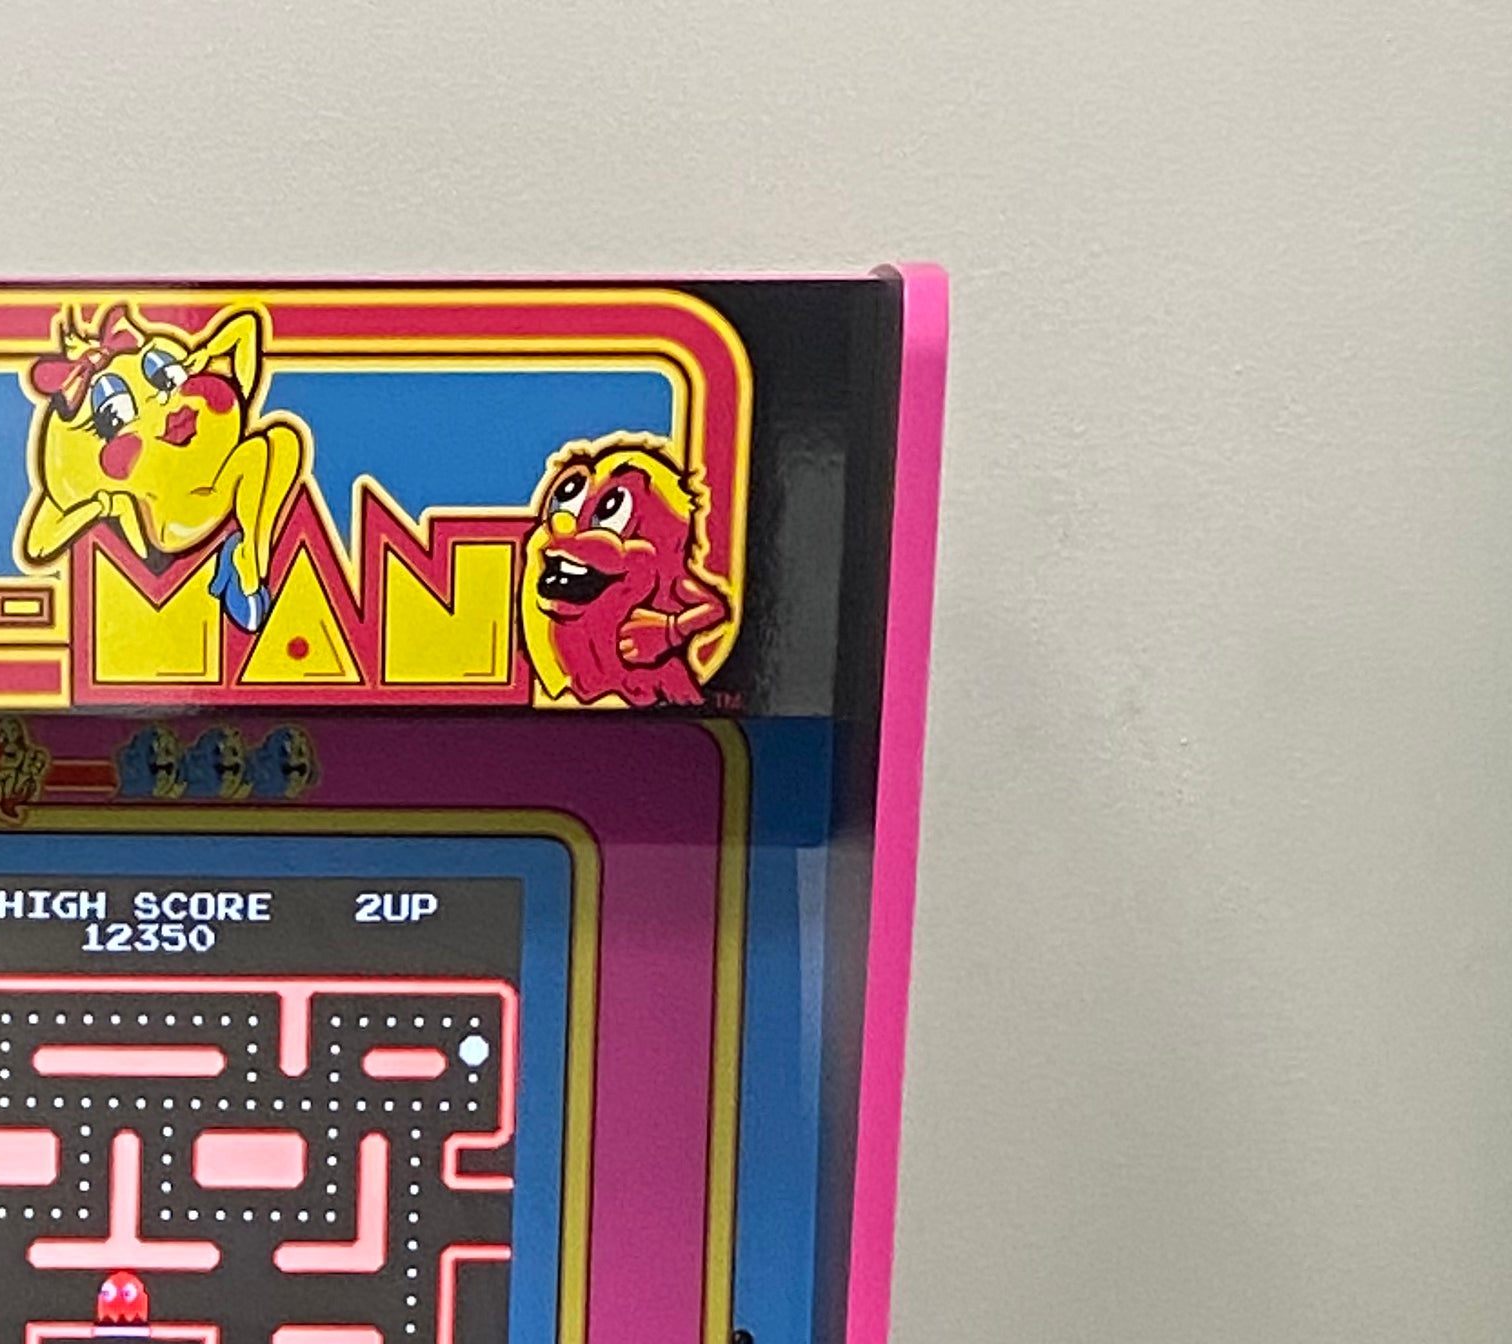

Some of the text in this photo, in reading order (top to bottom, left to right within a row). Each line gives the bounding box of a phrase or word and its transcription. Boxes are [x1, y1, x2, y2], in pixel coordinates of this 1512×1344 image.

[133, 891, 272, 924] SCORE
[354, 893, 439, 924] 2UP
[80, 923, 217, 952] 12350
